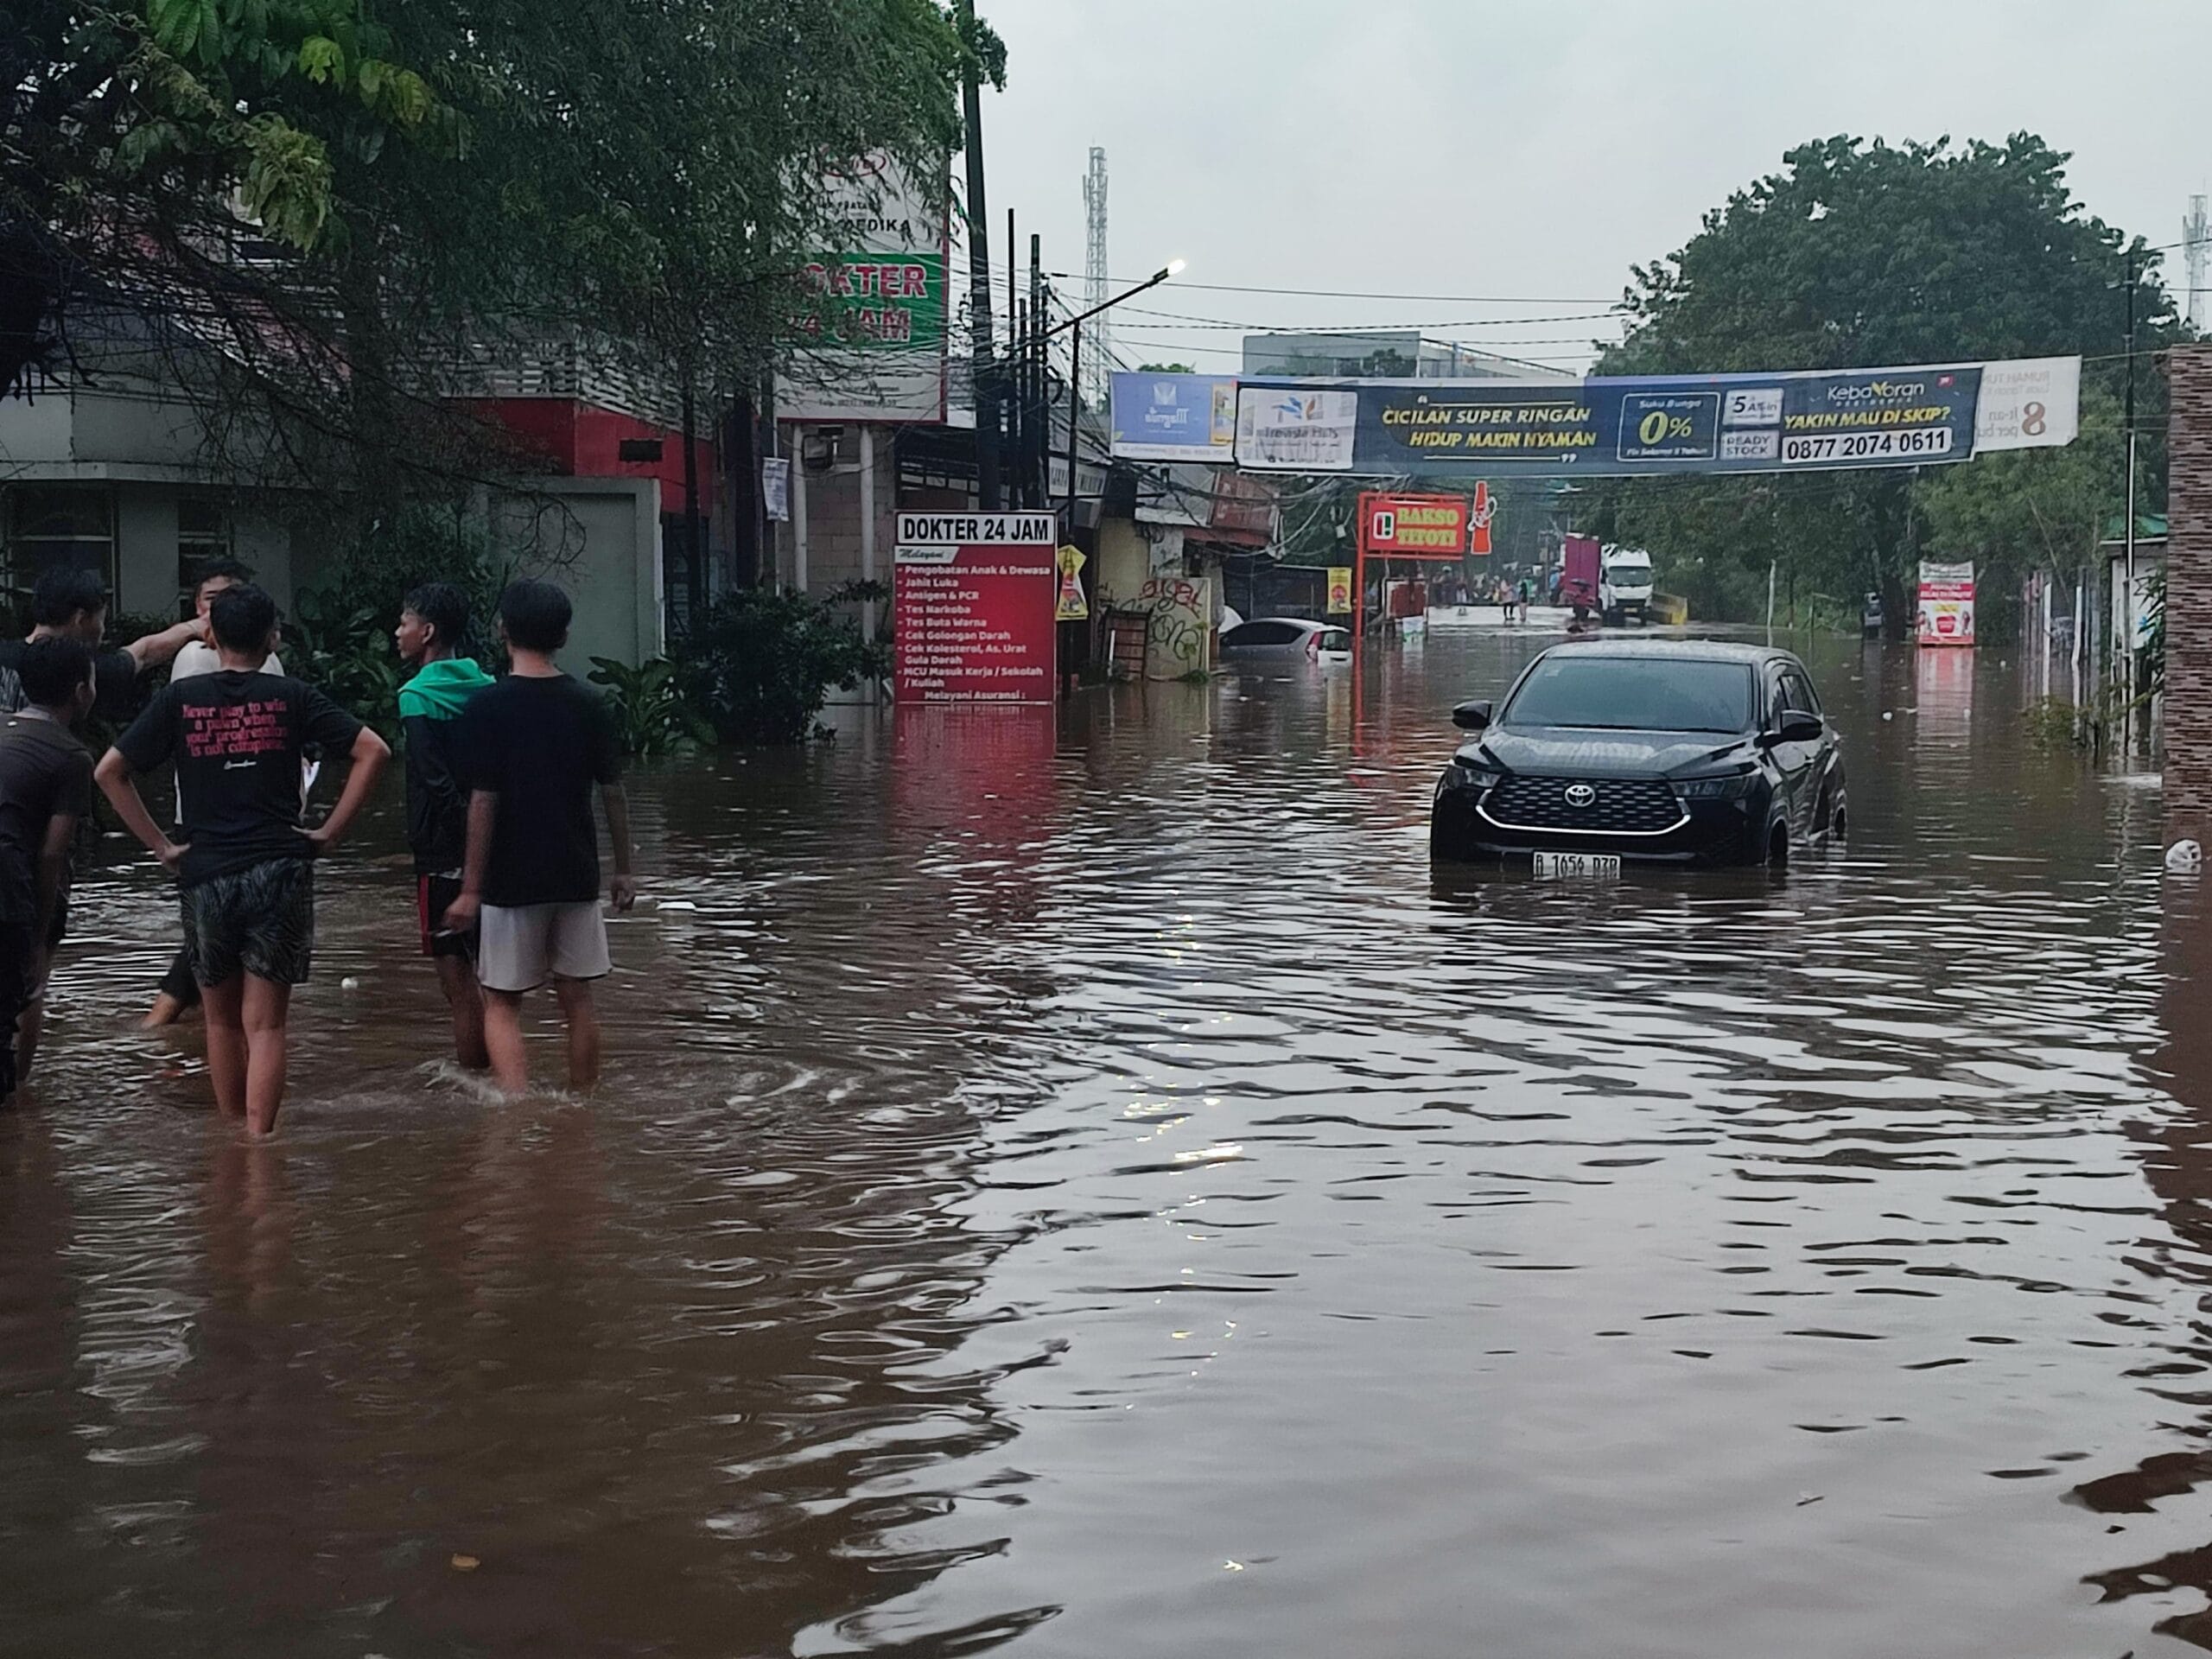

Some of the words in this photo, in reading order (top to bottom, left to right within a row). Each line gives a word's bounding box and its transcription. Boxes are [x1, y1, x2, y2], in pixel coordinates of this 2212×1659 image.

[1732, 395, 1746, 413] 5
[1382, 408, 1450, 424] CICILAN
[1456, 409, 1512, 423] SUPER
[1516, 407, 1591, 423] RINGAN
[1784, 412, 1839, 429] YAKIN
[1839, 410, 1881, 426] MAU
[1882, 410, 1902, 424] DI
[1902, 406, 1951, 423] SKIP?
[1639, 410, 1692, 446] 0%
[1409, 432, 1462, 447] HIDUP
[1466, 432, 1519, 447] MAKIN
[1523, 431, 1596, 447] NYAMAN
[1726, 435, 1770, 445] READY
[1726, 446, 1769, 455] STOCK
[1787, 437, 1836, 461] 0877
[1843, 434, 1891, 456] 2074
[1899, 430, 1945, 452] 0611
[1396, 507, 1459, 526] BAKSO
[904, 518, 978, 541] DOKTER
[984, 518, 1006, 541] 24
[1011, 518, 1048, 541] JAM
[905, 565, 969, 576] Pengobatan
[970, 565, 997, 575] Anak
[999, 566, 1007, 575] &
[1009, 566, 1051, 575] Dewasa
[905, 578, 931, 588] Jahit
[933, 578, 958, 588] Luka
[905, 591, 947, 602] Antigen
[949, 592, 957, 601] &
[959, 591, 979, 601] PCR
[925, 605, 971, 614] Narkoba
[905, 618, 924, 626] Tes
[926, 618, 950, 626] Buta
[953, 618, 987, 627] Warna
[905, 631, 925, 639] Cek
[926, 631, 977, 641] Golongan
[979, 631, 1010, 639] Darah
[905, 644, 925, 653] Cek
[1003, 644, 1027, 653] Urat
[905, 655, 929, 664] Gula
[931, 655, 963, 664] Darah
[904, 667, 926, 677] MCU
[929, 667, 963, 677] Masuk
[965, 667, 993, 677] Kerja
[1001, 667, 1043, 677] Sekolah
[911, 678, 944, 688] Kuliah
[925, 690, 972, 702] Melayani
[974, 690, 1020, 700] Asuransi
[182, 704, 216, 718] Never
[247, 702, 261, 714] to
[194, 719, 203, 730] a
[243, 714, 276, 727] when
